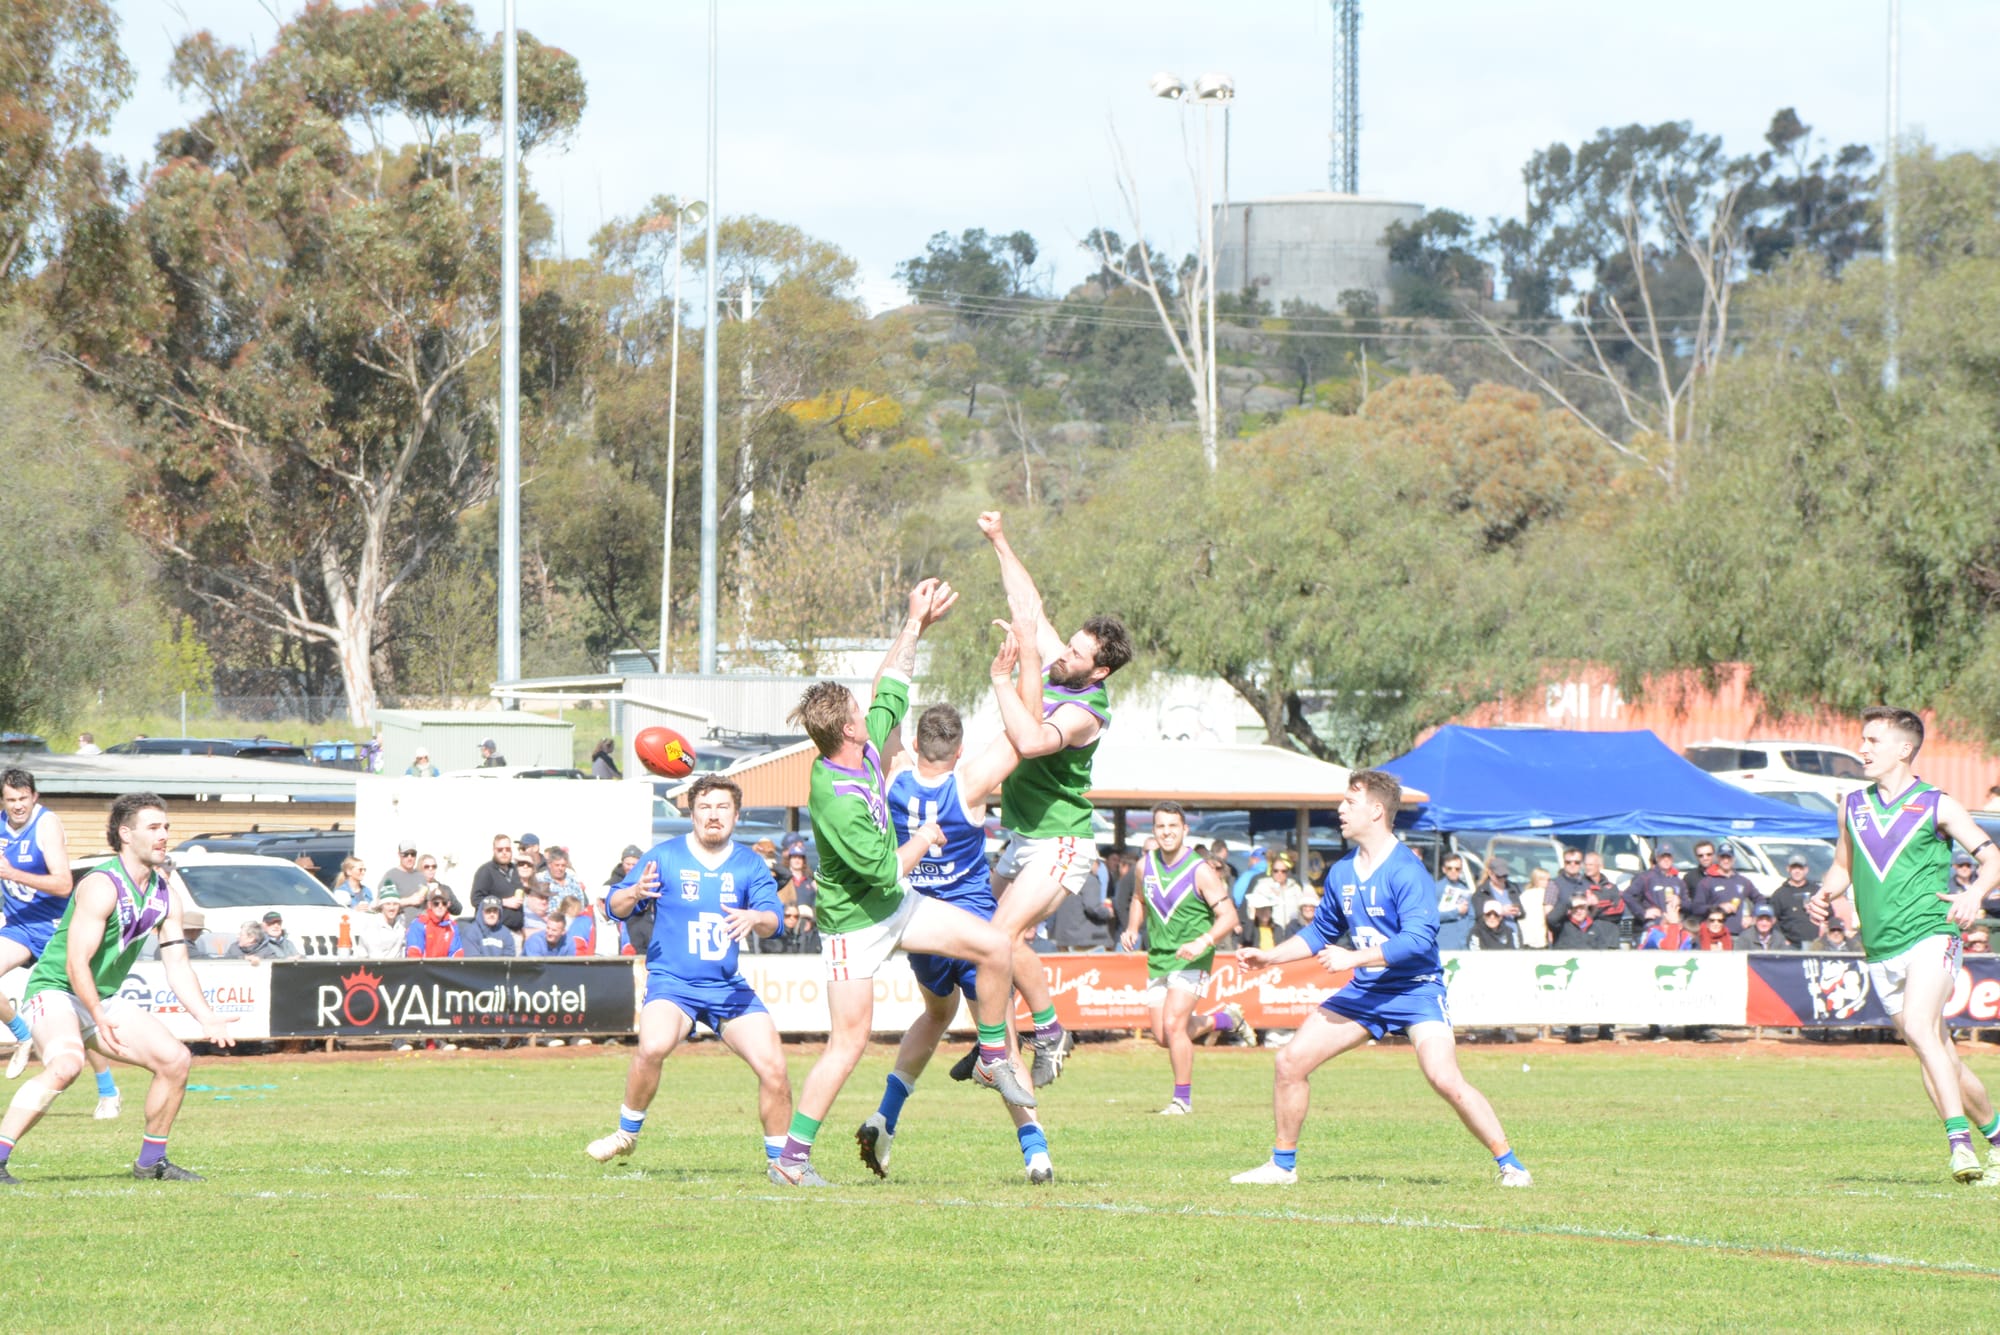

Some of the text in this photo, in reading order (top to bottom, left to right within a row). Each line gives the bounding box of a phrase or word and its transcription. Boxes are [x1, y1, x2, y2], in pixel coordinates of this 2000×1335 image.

[317, 983, 586, 1027] ROYAL mail hotel
[452, 1014, 585, 1025] WYCHEPROOF
